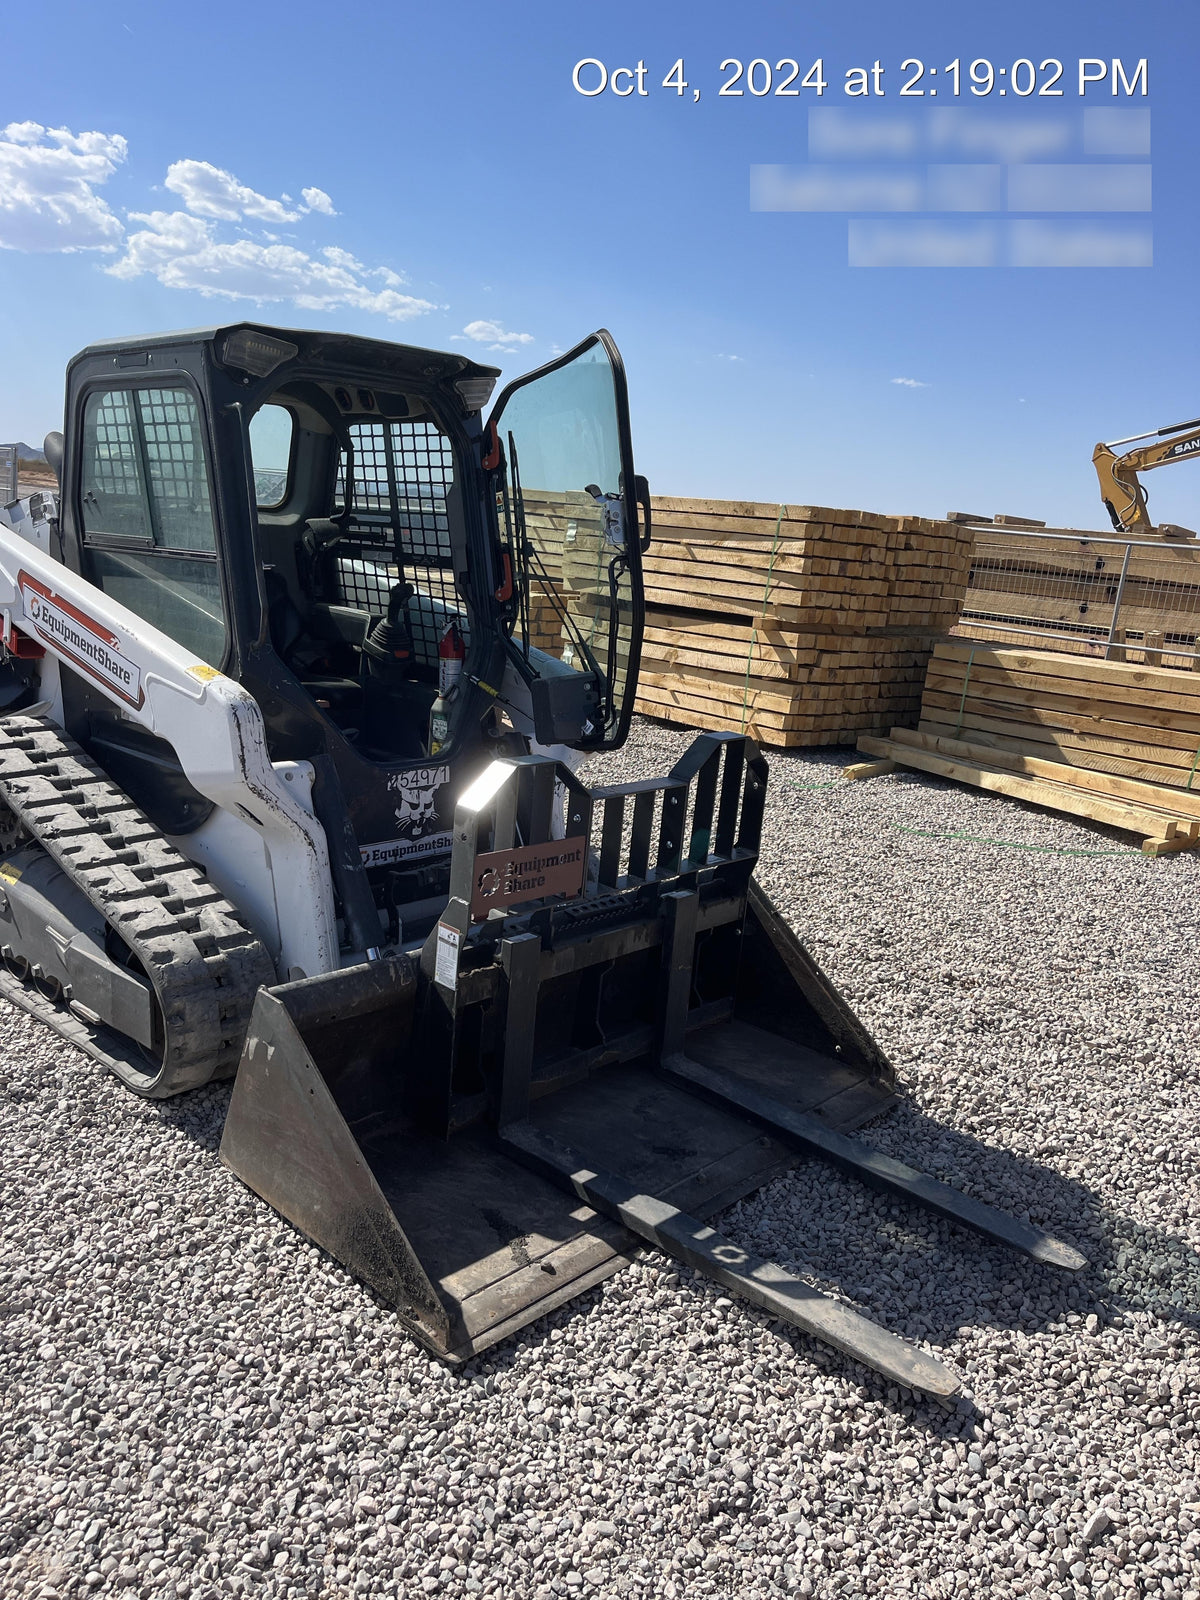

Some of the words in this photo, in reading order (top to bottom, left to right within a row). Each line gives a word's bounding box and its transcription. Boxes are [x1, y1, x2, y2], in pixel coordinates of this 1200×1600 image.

[41, 606, 131, 685] EquipmentShare
[372, 837, 453, 862] EquipmentSh
[504, 848, 582, 877] Equipment
[503, 875, 546, 895] Share
